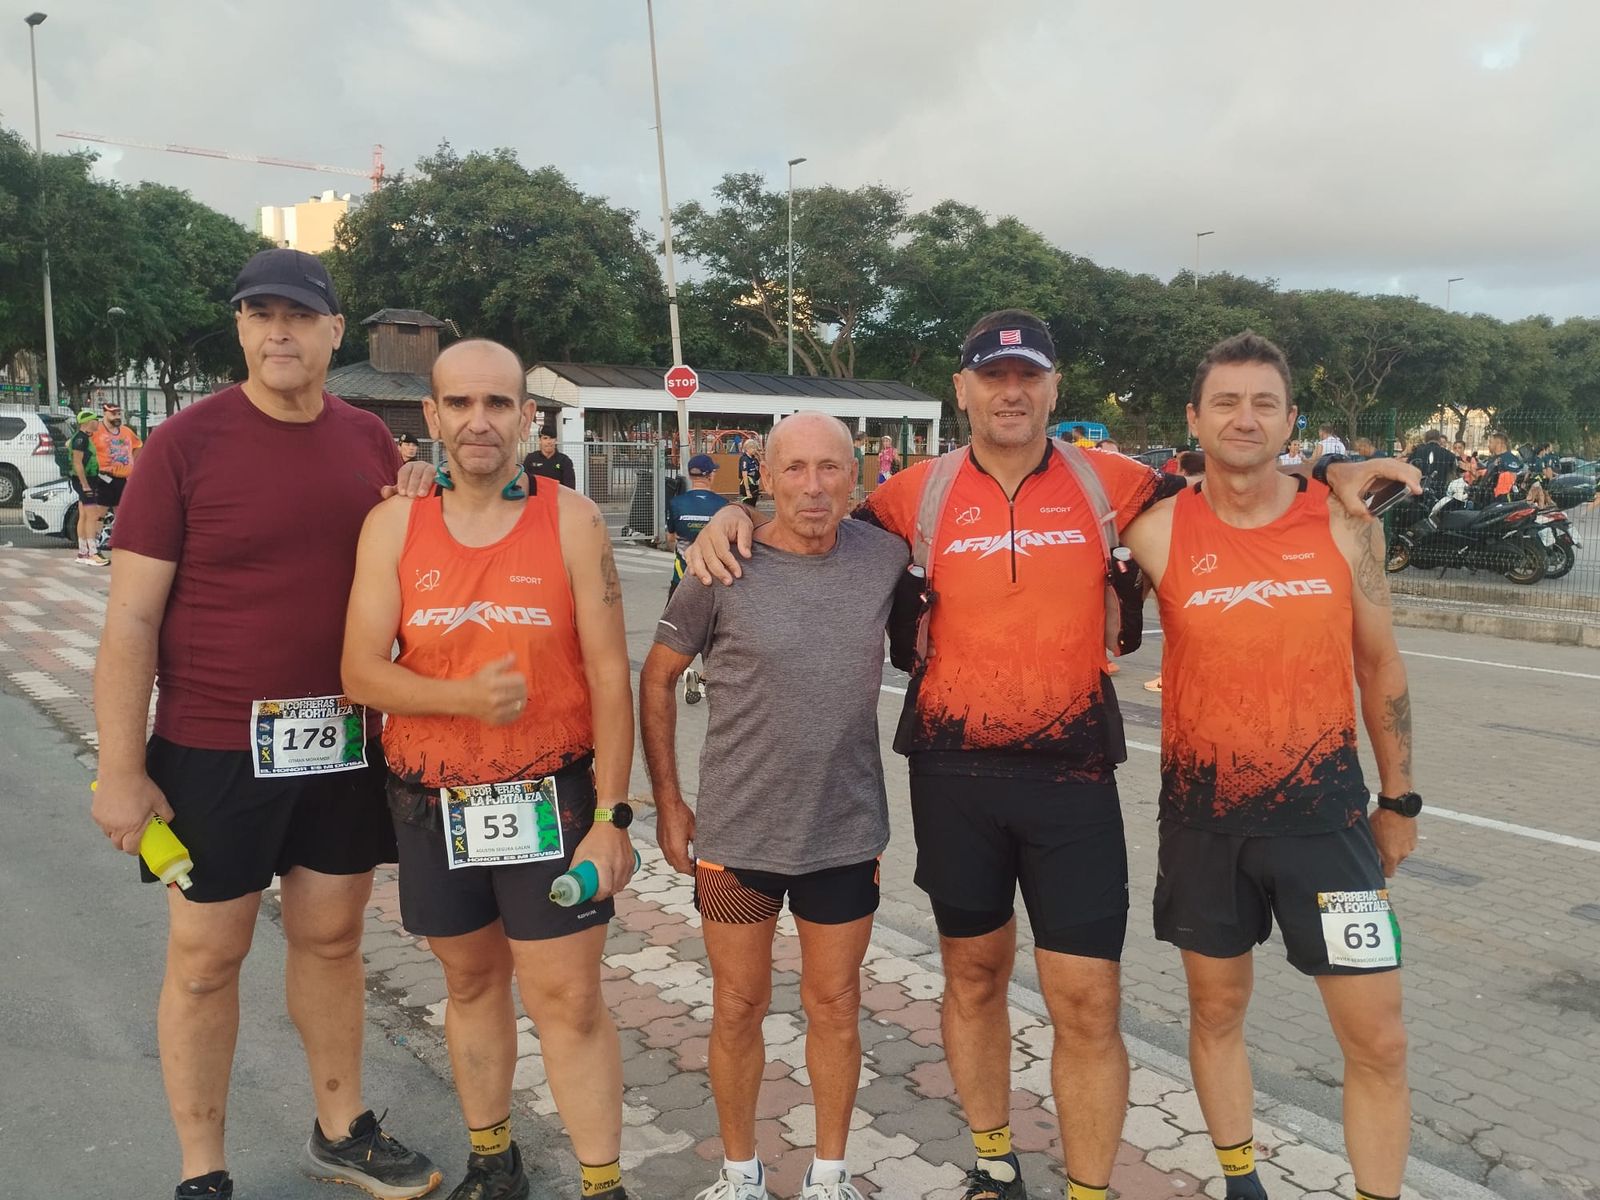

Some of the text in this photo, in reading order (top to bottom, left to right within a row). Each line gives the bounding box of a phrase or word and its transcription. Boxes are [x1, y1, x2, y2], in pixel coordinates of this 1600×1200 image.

[668, 378, 695, 387] STOP
[943, 529, 1086, 560] AFRIKANOS
[1282, 552, 1315, 561] GSPORT
[509, 575, 543, 585] GSPORT
[1183, 579, 1333, 613] AFRIKANOS
[406, 601, 552, 637] AFRIKANOS
[287, 699, 335, 710] CORRERAS
[282, 705, 354, 719] LA FORTALEZA
[283, 726, 337, 751] 178
[472, 785, 521, 797] CORERAS
[470, 796, 485, 806] LA
[483, 813, 519, 840] 53
[1329, 890, 1378, 903] CORRERAS
[1327, 902, 1344, 913] LA
[1344, 922, 1381, 949] 63
